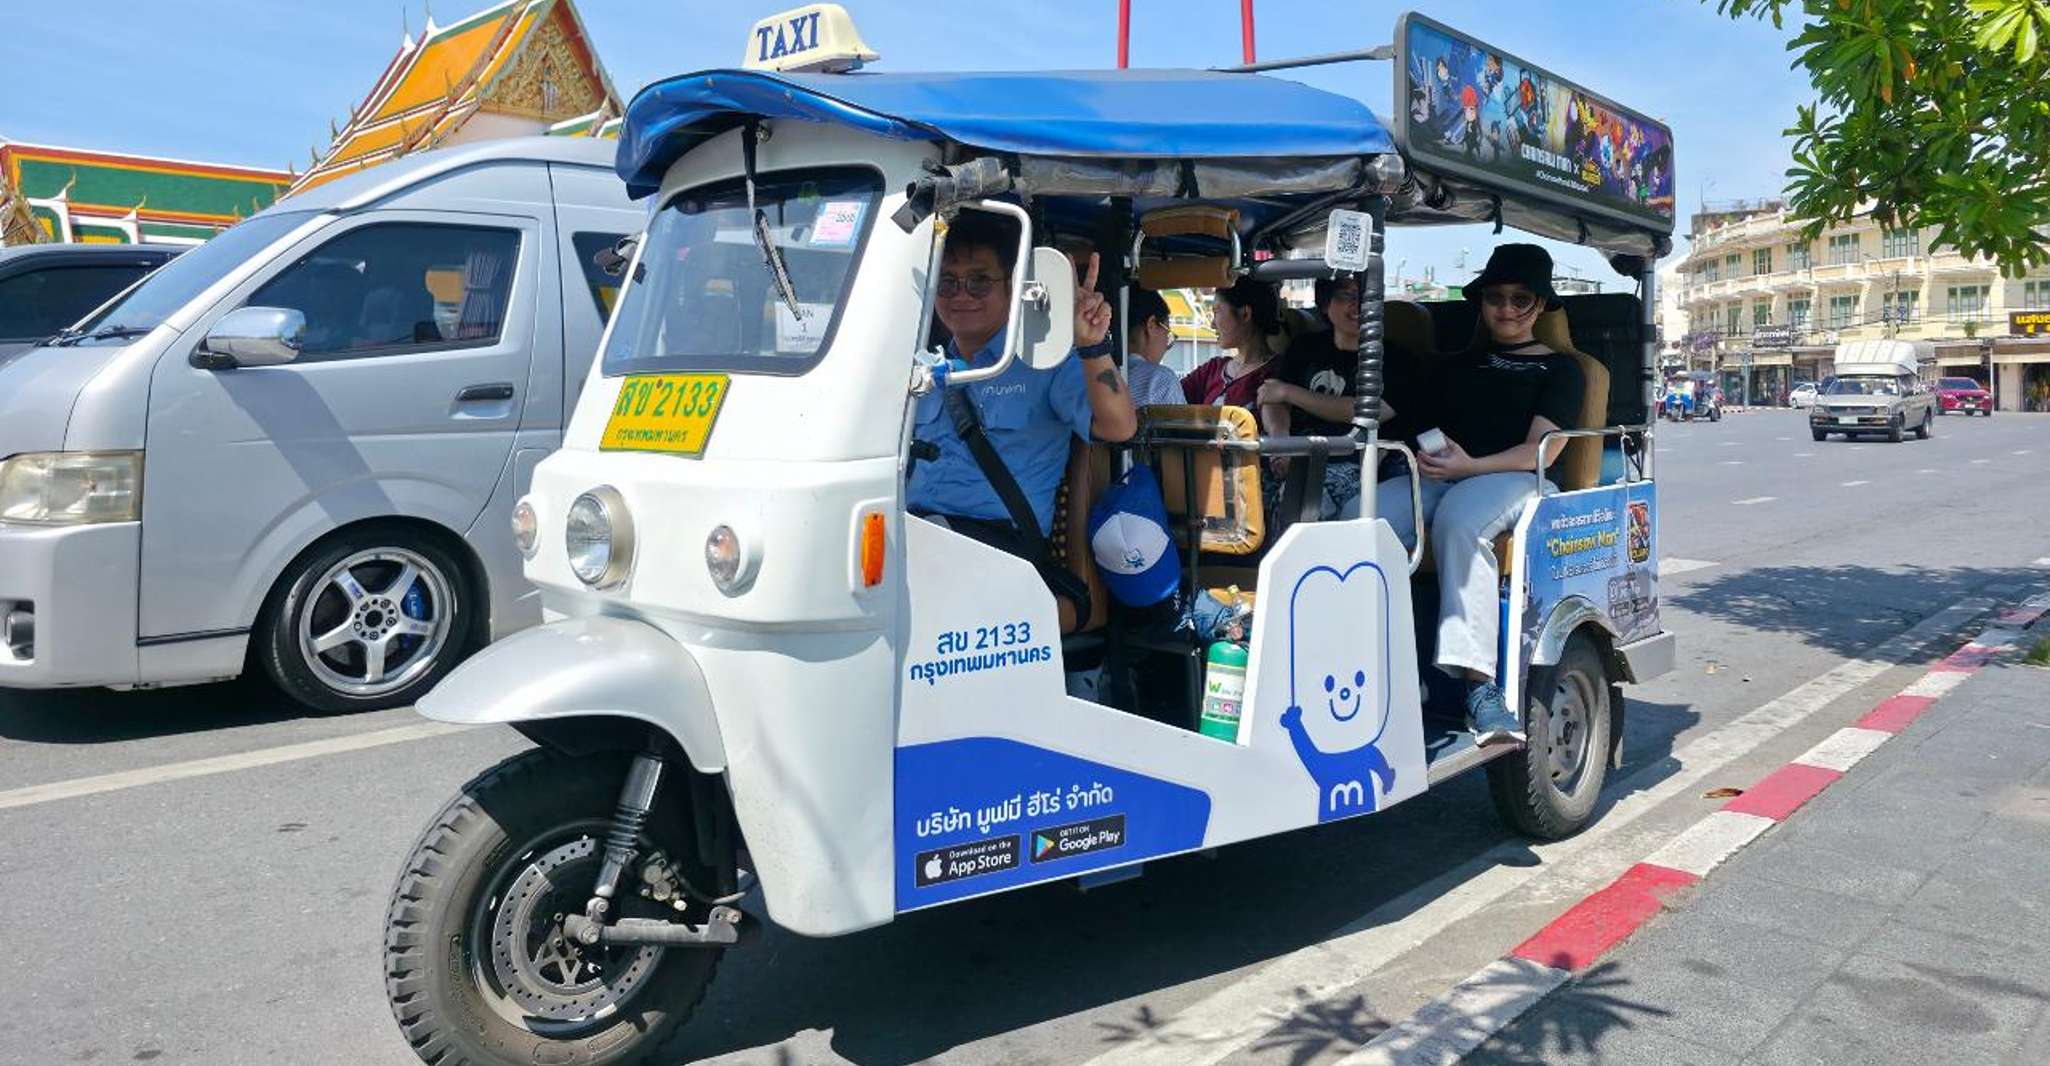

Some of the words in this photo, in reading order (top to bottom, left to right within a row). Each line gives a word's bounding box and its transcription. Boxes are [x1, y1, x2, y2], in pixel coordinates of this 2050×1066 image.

[757, 12, 820, 61] TAXI
[652, 380, 719, 417] 2133
[936, 630, 969, 655] สข
[975, 621, 1032, 650] 2133
[910, 645, 1052, 686] กรุงเทพมหานคร
[916, 807, 972, 838] บริษัท
[976, 794, 1022, 834] มูฟมี
[1026, 787, 1062, 818] ฮีโร่
[1066, 781, 1114, 812] จำกัด
[1059, 833, 1098, 851] Google
[1098, 829, 1120, 844] Play
[949, 860, 976, 877] App
[977, 853, 1012, 869] Store
